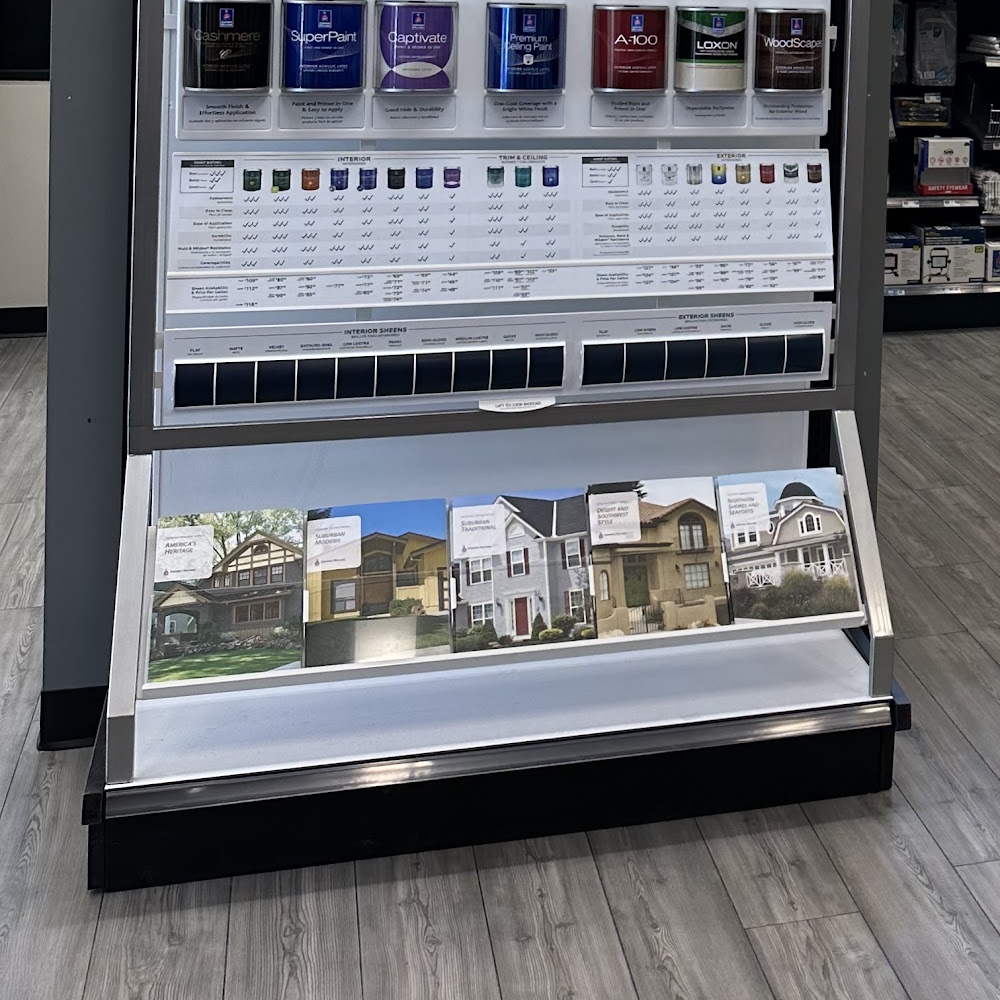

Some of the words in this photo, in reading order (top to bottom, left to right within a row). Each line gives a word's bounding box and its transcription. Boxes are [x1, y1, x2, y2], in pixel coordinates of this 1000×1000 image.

[193, 29, 261, 42] Cashmere
[290, 30, 357, 44] SuperPaint
[388, 32, 448, 44] Captivate
[510, 34, 548, 43] Premium
[614, 34, 658, 45] A-100
[696, 41, 736, 50] LOXON
